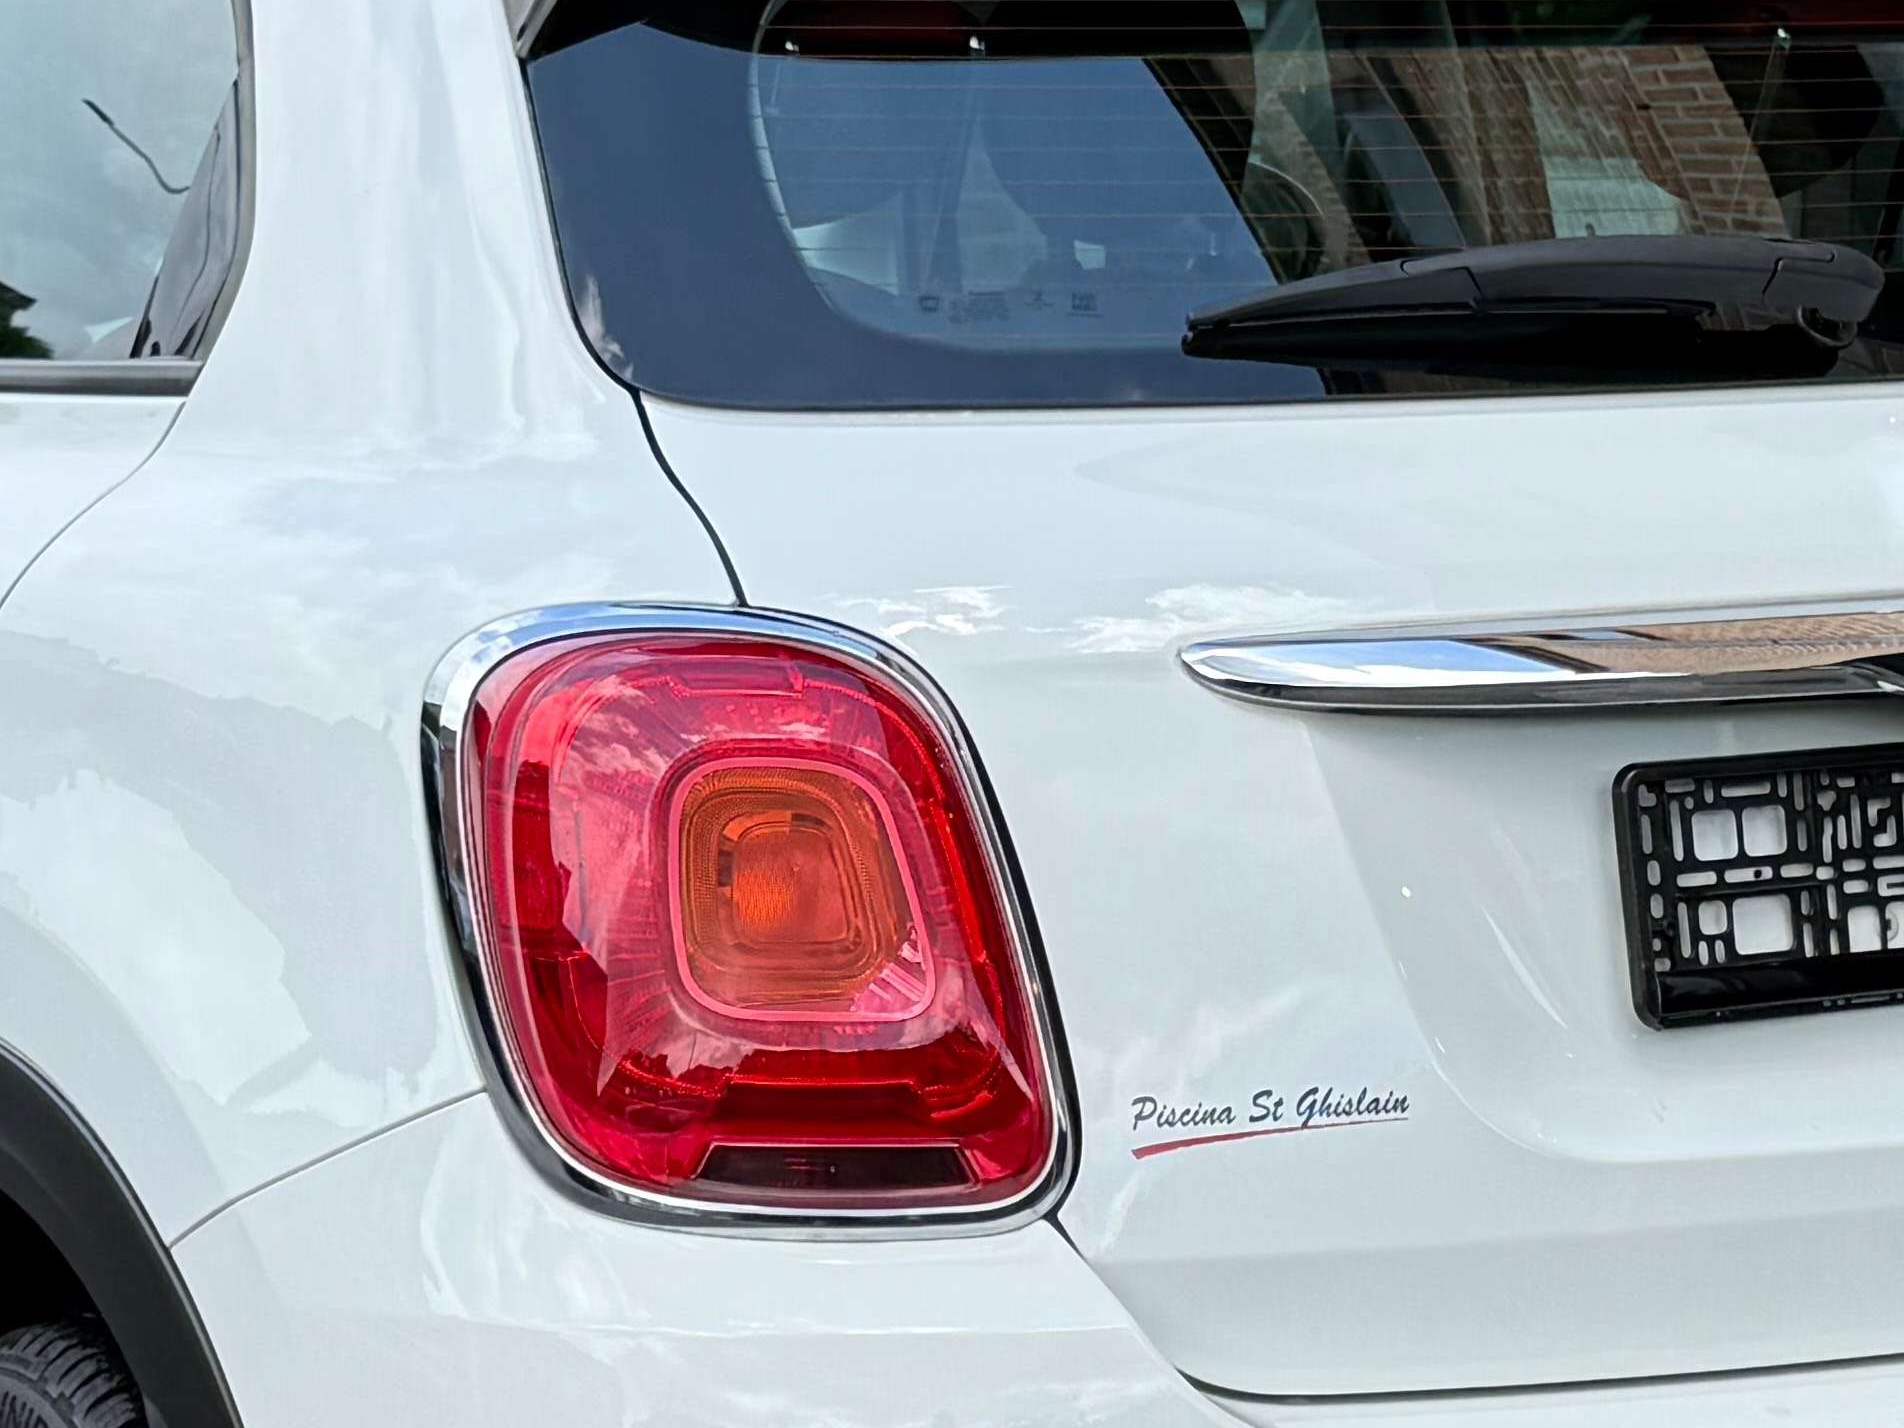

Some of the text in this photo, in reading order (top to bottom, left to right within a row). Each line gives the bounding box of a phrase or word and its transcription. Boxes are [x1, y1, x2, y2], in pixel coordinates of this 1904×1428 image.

[1131, 1086, 1410, 1131] Piscina St Ghislain
